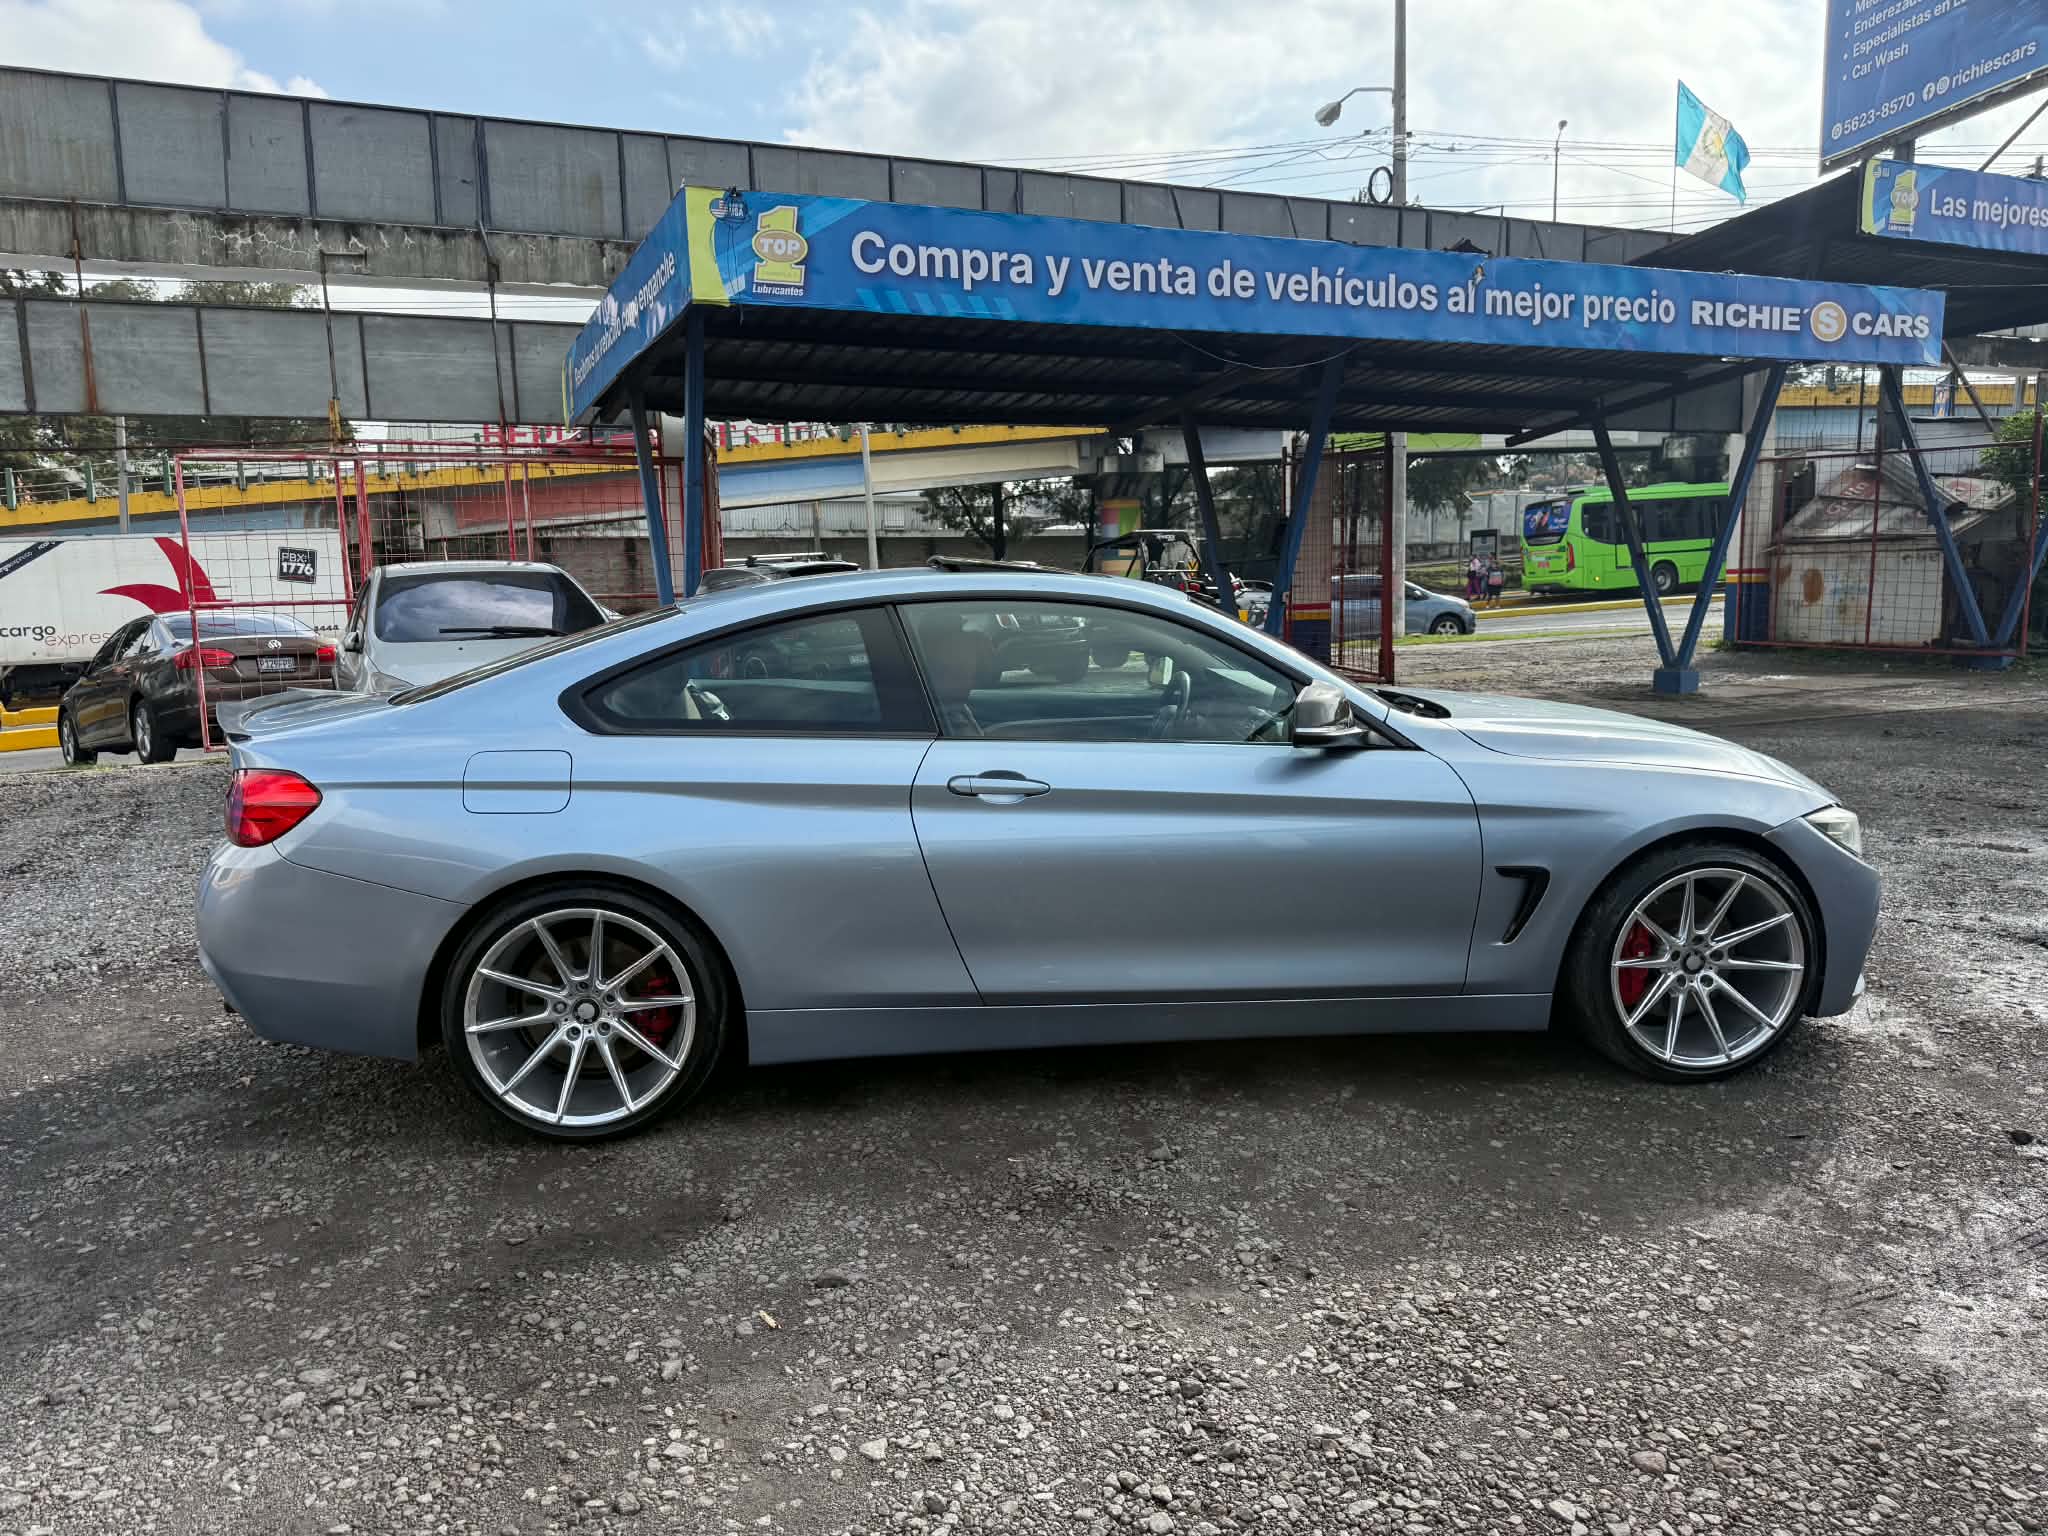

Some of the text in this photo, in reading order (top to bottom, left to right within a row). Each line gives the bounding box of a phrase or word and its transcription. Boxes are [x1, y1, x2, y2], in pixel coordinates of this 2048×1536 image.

[1853, 1, 1951, 57] Especialistas en
[1852, 42, 1909, 80] Car Wash
[1951, 41, 2038, 89] richiescars
[1843, 91, 1916, 135] 5623-8570
[1931, 188, 2048, 230] Las mejores
[760, 237, 801, 256] TOP
[639, 251, 675, 309] enganche
[752, 283, 804, 297] Lubricantes
[851, 231, 1034, 291] Compra
[1046, 255, 1071, 296] y
[1082, 257, 1196, 296] venta
[1207, 259, 1257, 298] de
[1264, 266, 1439, 312] vehículos
[1447, 279, 1477, 313] al
[1485, 282, 1576, 326] mejor
[1583, 289, 1676, 328] precio
[1852, 312, 1930, 338] CARS
[281, 552, 308, 563] PBX:
[281, 562, 314, 576] 1776
[0, 625, 56, 641] cargo
